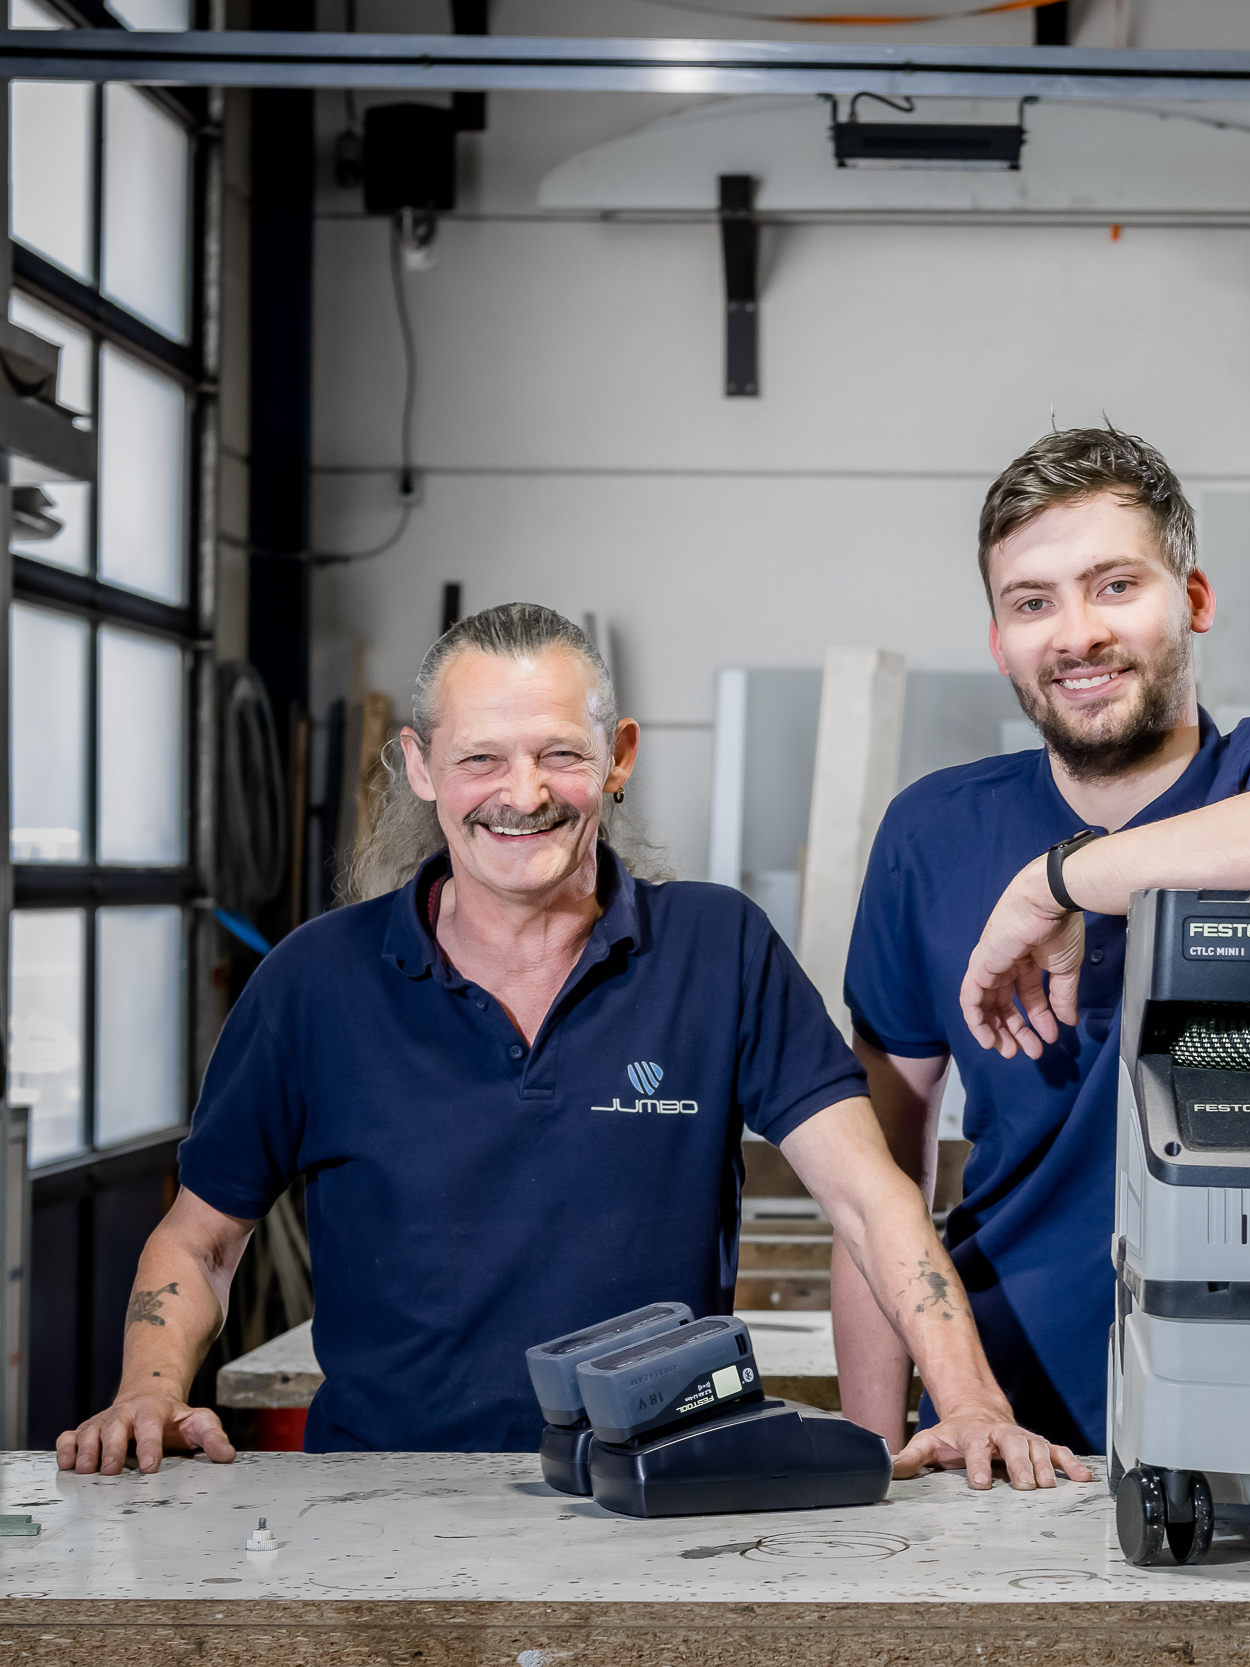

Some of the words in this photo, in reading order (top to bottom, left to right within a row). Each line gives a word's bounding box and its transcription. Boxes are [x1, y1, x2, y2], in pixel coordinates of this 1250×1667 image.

[1189, 946, 1215, 956] CTLC
[1216, 947, 1239, 956] MINI
[1240, 947, 1245, 957] I
[590, 1098, 698, 1114] JUMBO
[630, 1363, 678, 1386] AIRSTREAM
[638, 1399, 648, 1411] V
[650, 1390, 665, 1406] 18
[675, 1395, 715, 1413] FESTOOL
